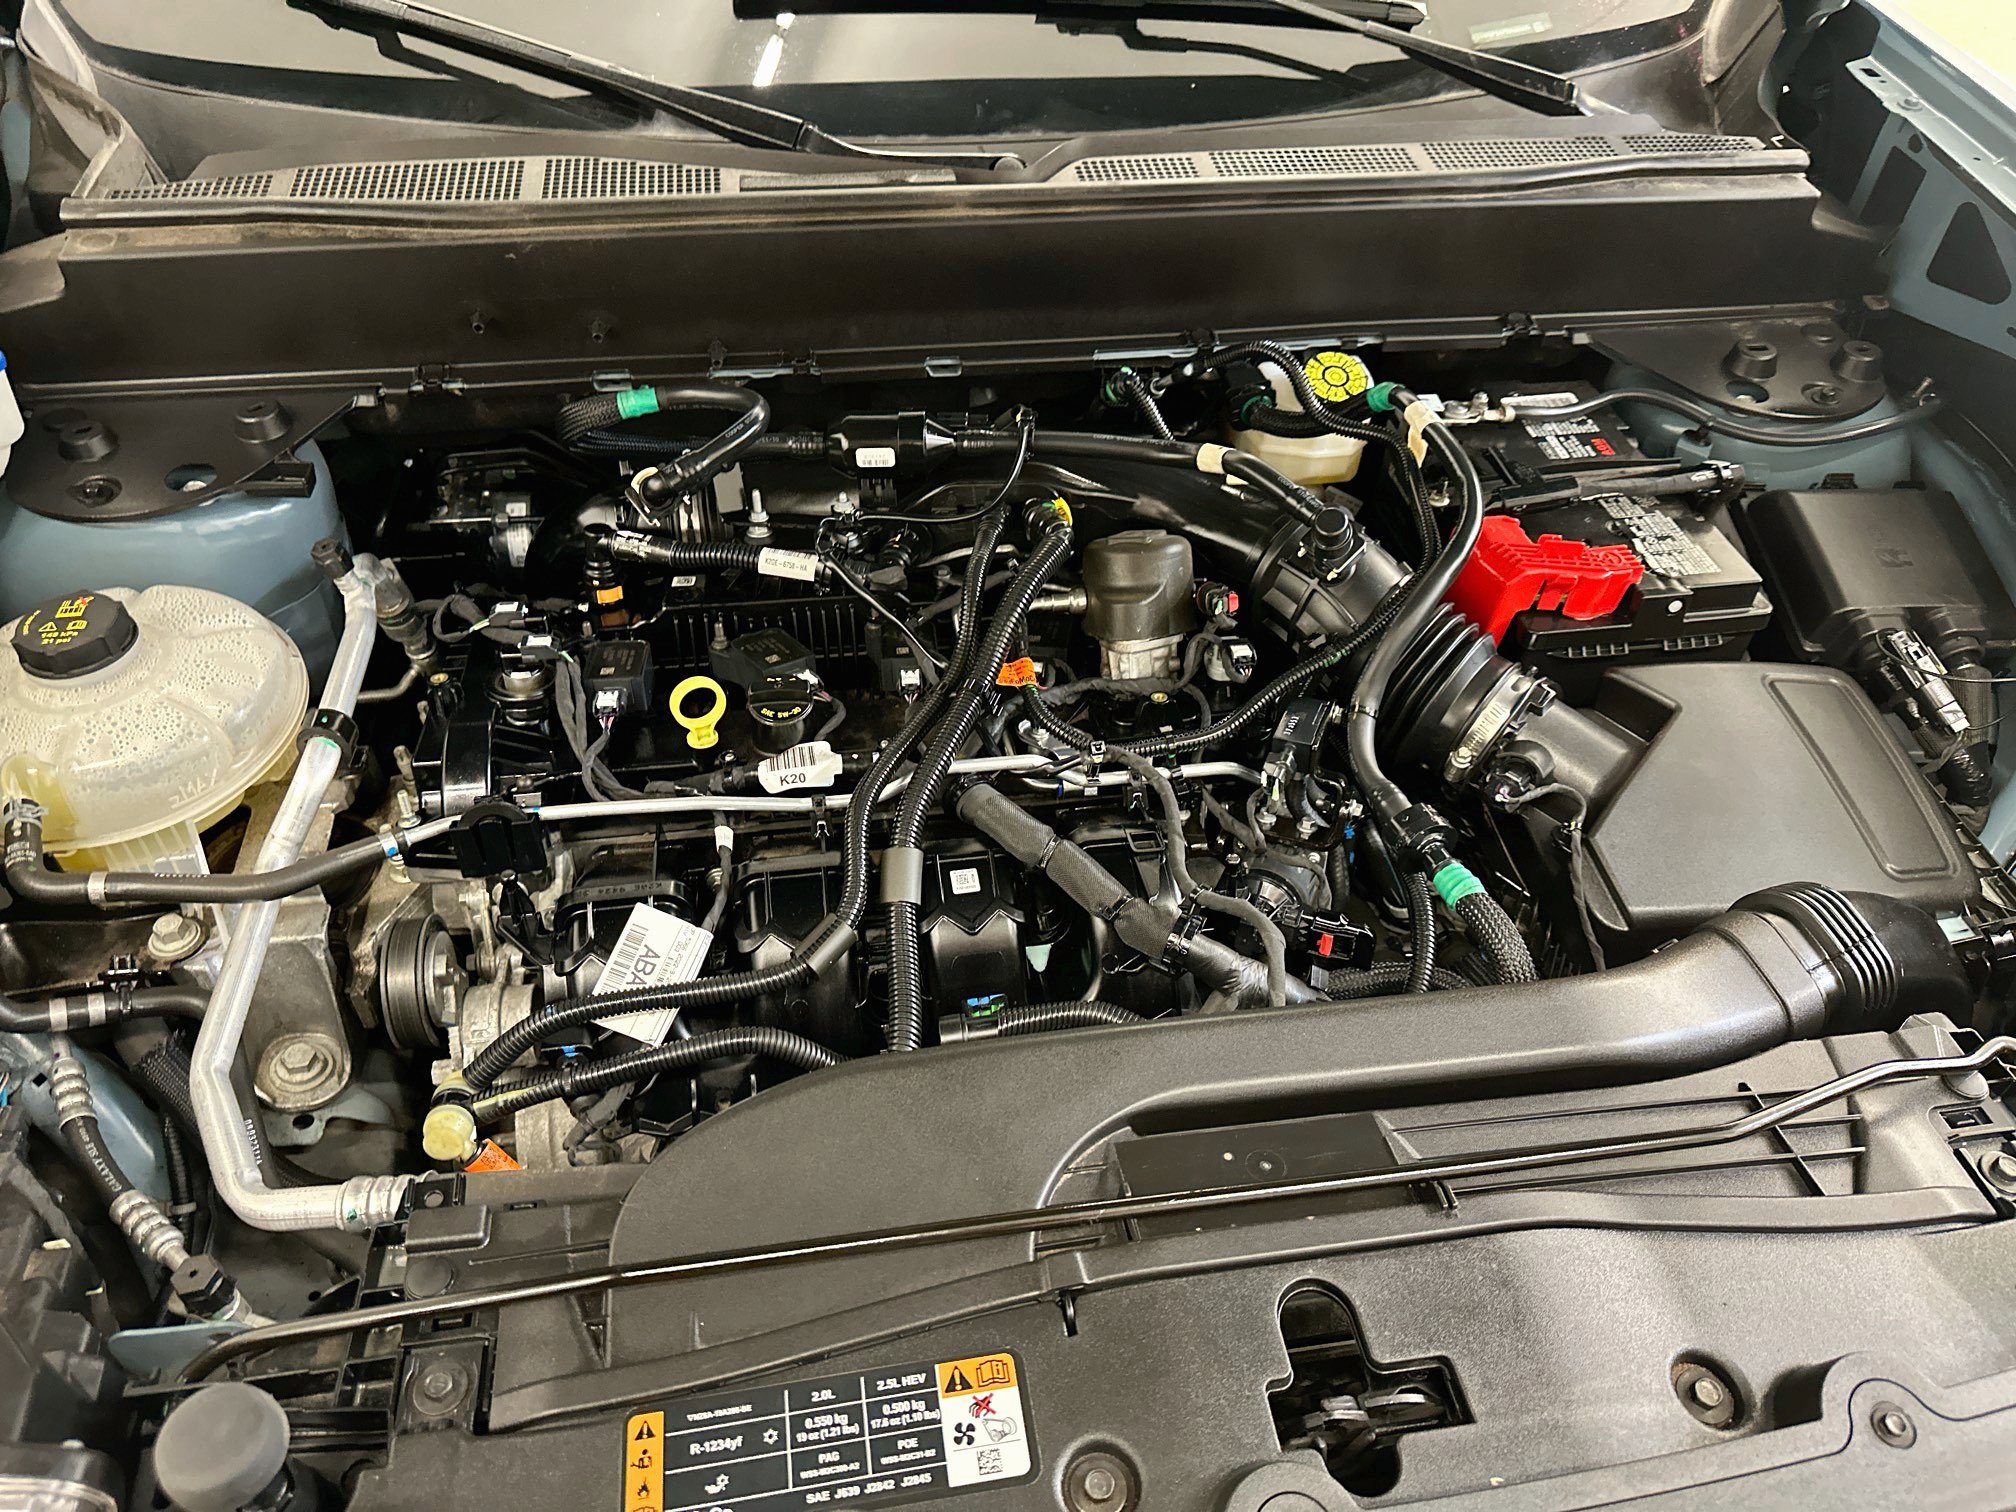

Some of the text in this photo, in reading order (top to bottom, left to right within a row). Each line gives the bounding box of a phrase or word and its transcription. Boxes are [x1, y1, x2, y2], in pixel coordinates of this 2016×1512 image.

[761, 708, 775, 718] SAE
[779, 772, 806, 786] K20
[625, 944, 661, 985] ABA
[93, 1157, 122, 1192] GALAXY
[876, 1372, 927, 1391] 2.5L HEV
[811, 1388, 837, 1402] 2.0L
[911, 1399, 926, 1412] kg
[804, 1412, 849, 1430] 0.550 kg
[689, 1435, 744, 1456] R-1234yf
[897, 1437, 919, 1450] POE
[818, 1450, 840, 1464] PAG
[805, 1490, 831, 1504] SAE
[834, 1485, 861, 1499] J639
